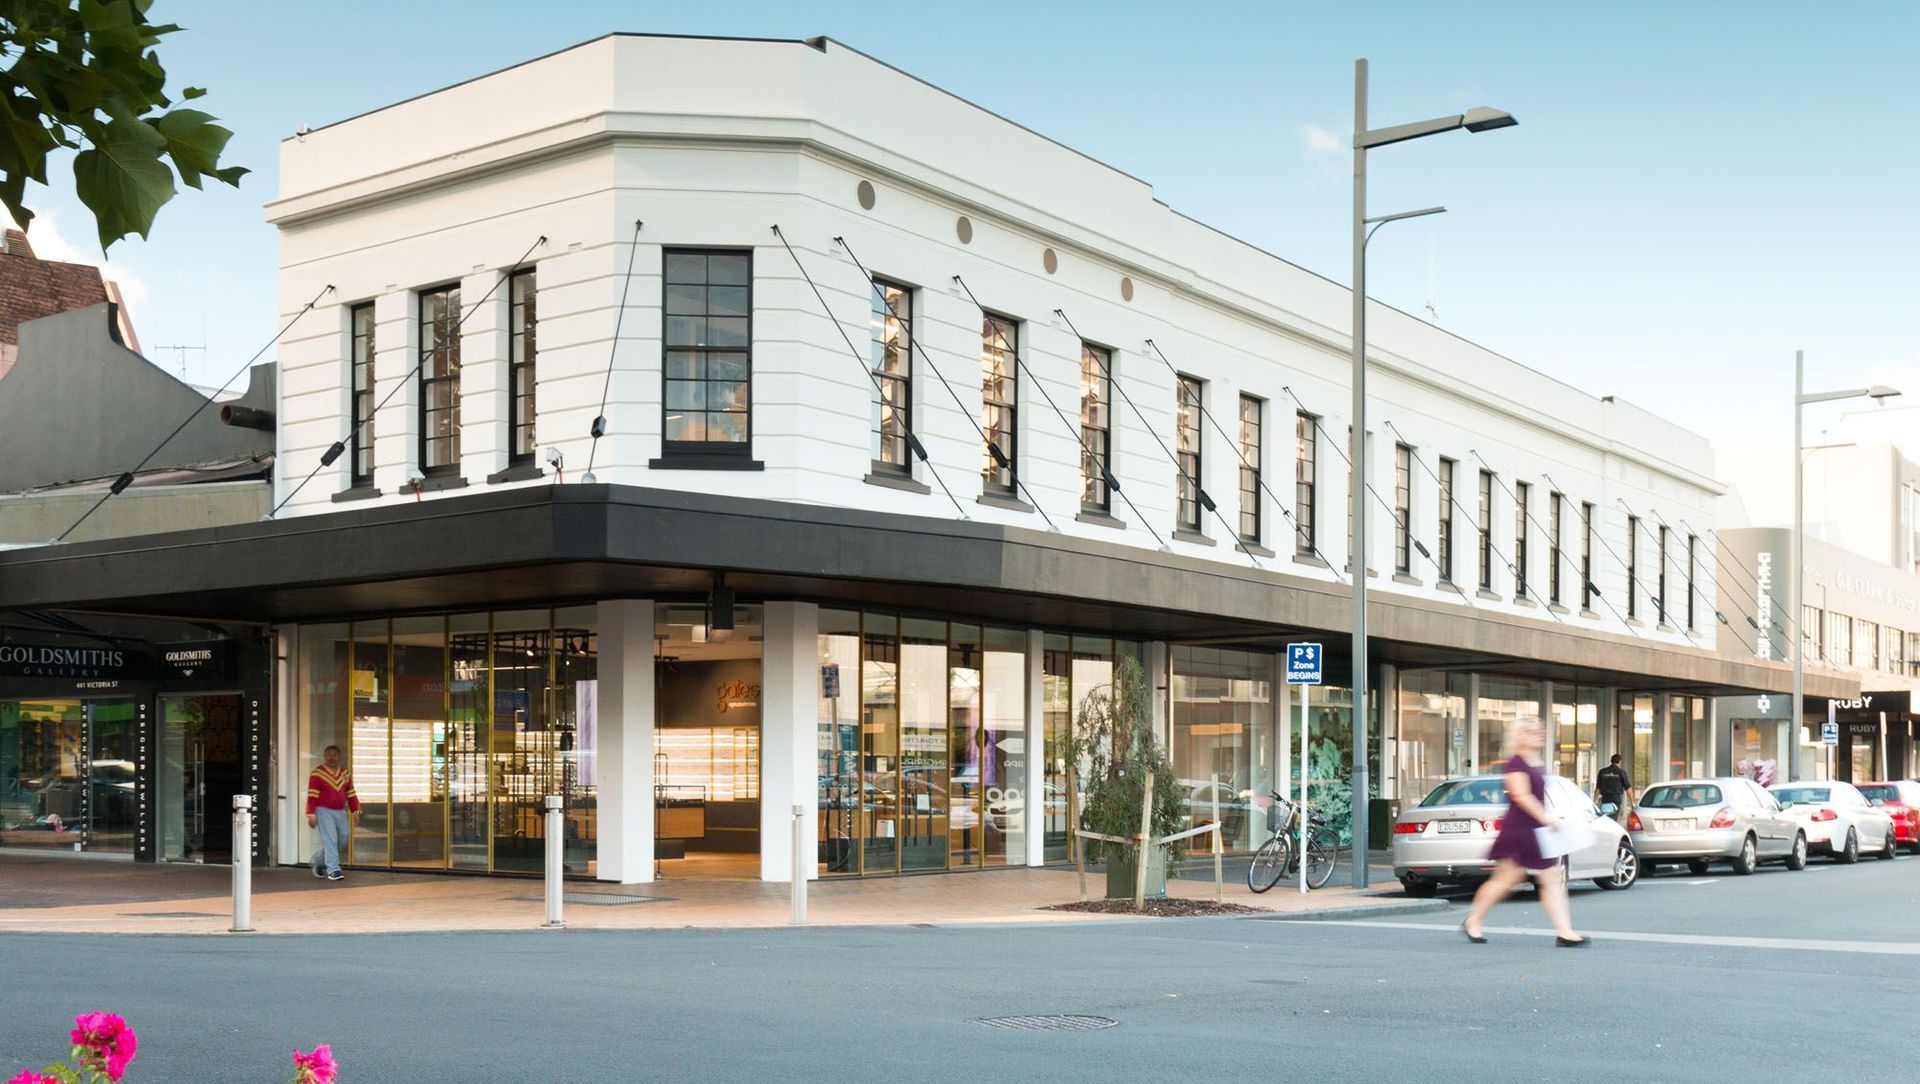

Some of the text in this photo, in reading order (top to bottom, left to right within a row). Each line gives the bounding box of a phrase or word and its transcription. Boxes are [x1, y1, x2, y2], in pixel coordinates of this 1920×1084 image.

[0, 647, 124, 667] GOLDSMITHS
[165, 649, 212, 661] GOLDSMITHS
[1293, 661, 1315, 669] Zone
[1288, 671, 1320, 680] BEGINS
[87, 681, 111, 689] VICTORIA
[1849, 723, 1877, 733] RUBY
